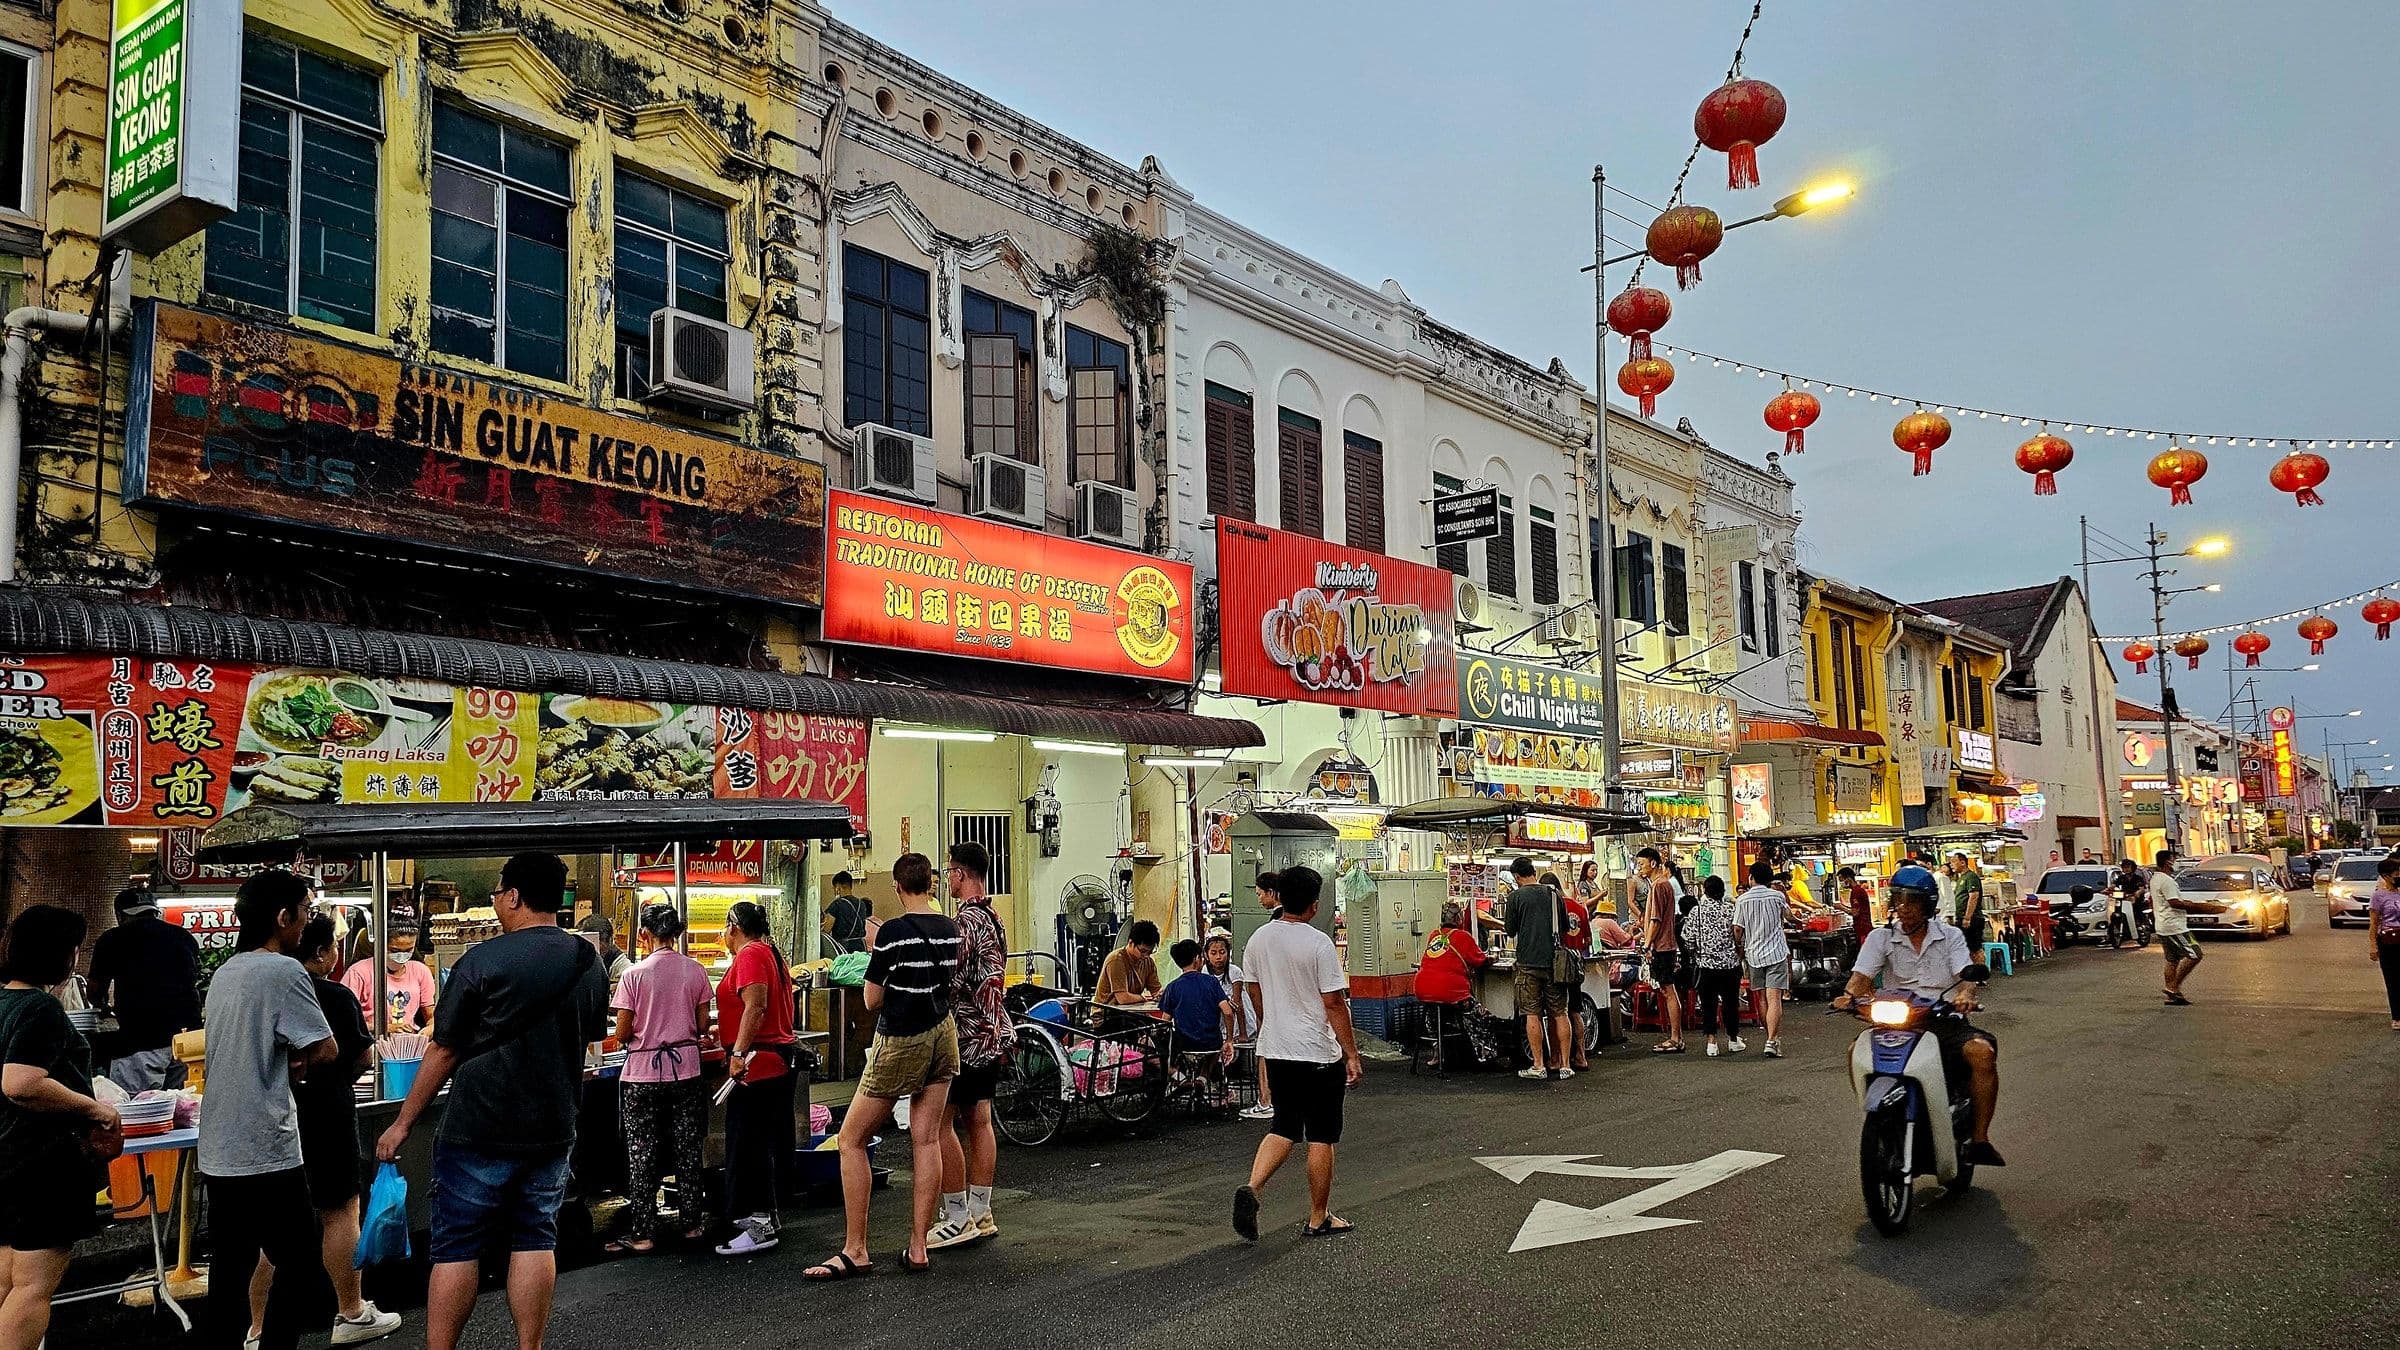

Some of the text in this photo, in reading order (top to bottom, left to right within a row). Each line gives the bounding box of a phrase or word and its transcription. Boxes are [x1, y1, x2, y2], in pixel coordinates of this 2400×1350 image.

[119, 4, 181, 57] KEDAI MAKAN DAN
[115, 43, 180, 119] SIN GUAT
[119, 91, 171, 158] KEONG
[394, 389, 706, 499] SIN GUAT KEONG
[836, 505, 943, 548] RESTORAN
[836, 538, 1110, 606] TRADITIONAL HOME OF DESSERT
[1319, 562, 1378, 591] Kimberly
[885, 580, 1072, 643] 汕頭街四果湯
[1350, 598, 1423, 655] Durian
[956, 629, 1012, 649] Since 1933
[150, 662, 215, 693] 馳名
[467, 688, 517, 721] 99
[1501, 692, 1579, 728] Chill Night
[1898, 694, 1917, 742] 漳泉
[764, 711, 864, 742] 99 PENANG
[811, 728, 856, 745] LAKSA
[109, 717, 134, 805] 潮州正宗
[321, 743, 446, 762] Penang Laksa
[2242, 759, 2260, 771] 4D
[366, 774, 440, 800] 炸薄餅
[764, 747, 865, 804] 叻沙
[2136, 803, 2160, 811] GAS
[690, 861, 760, 877] PENANG LAKSA
